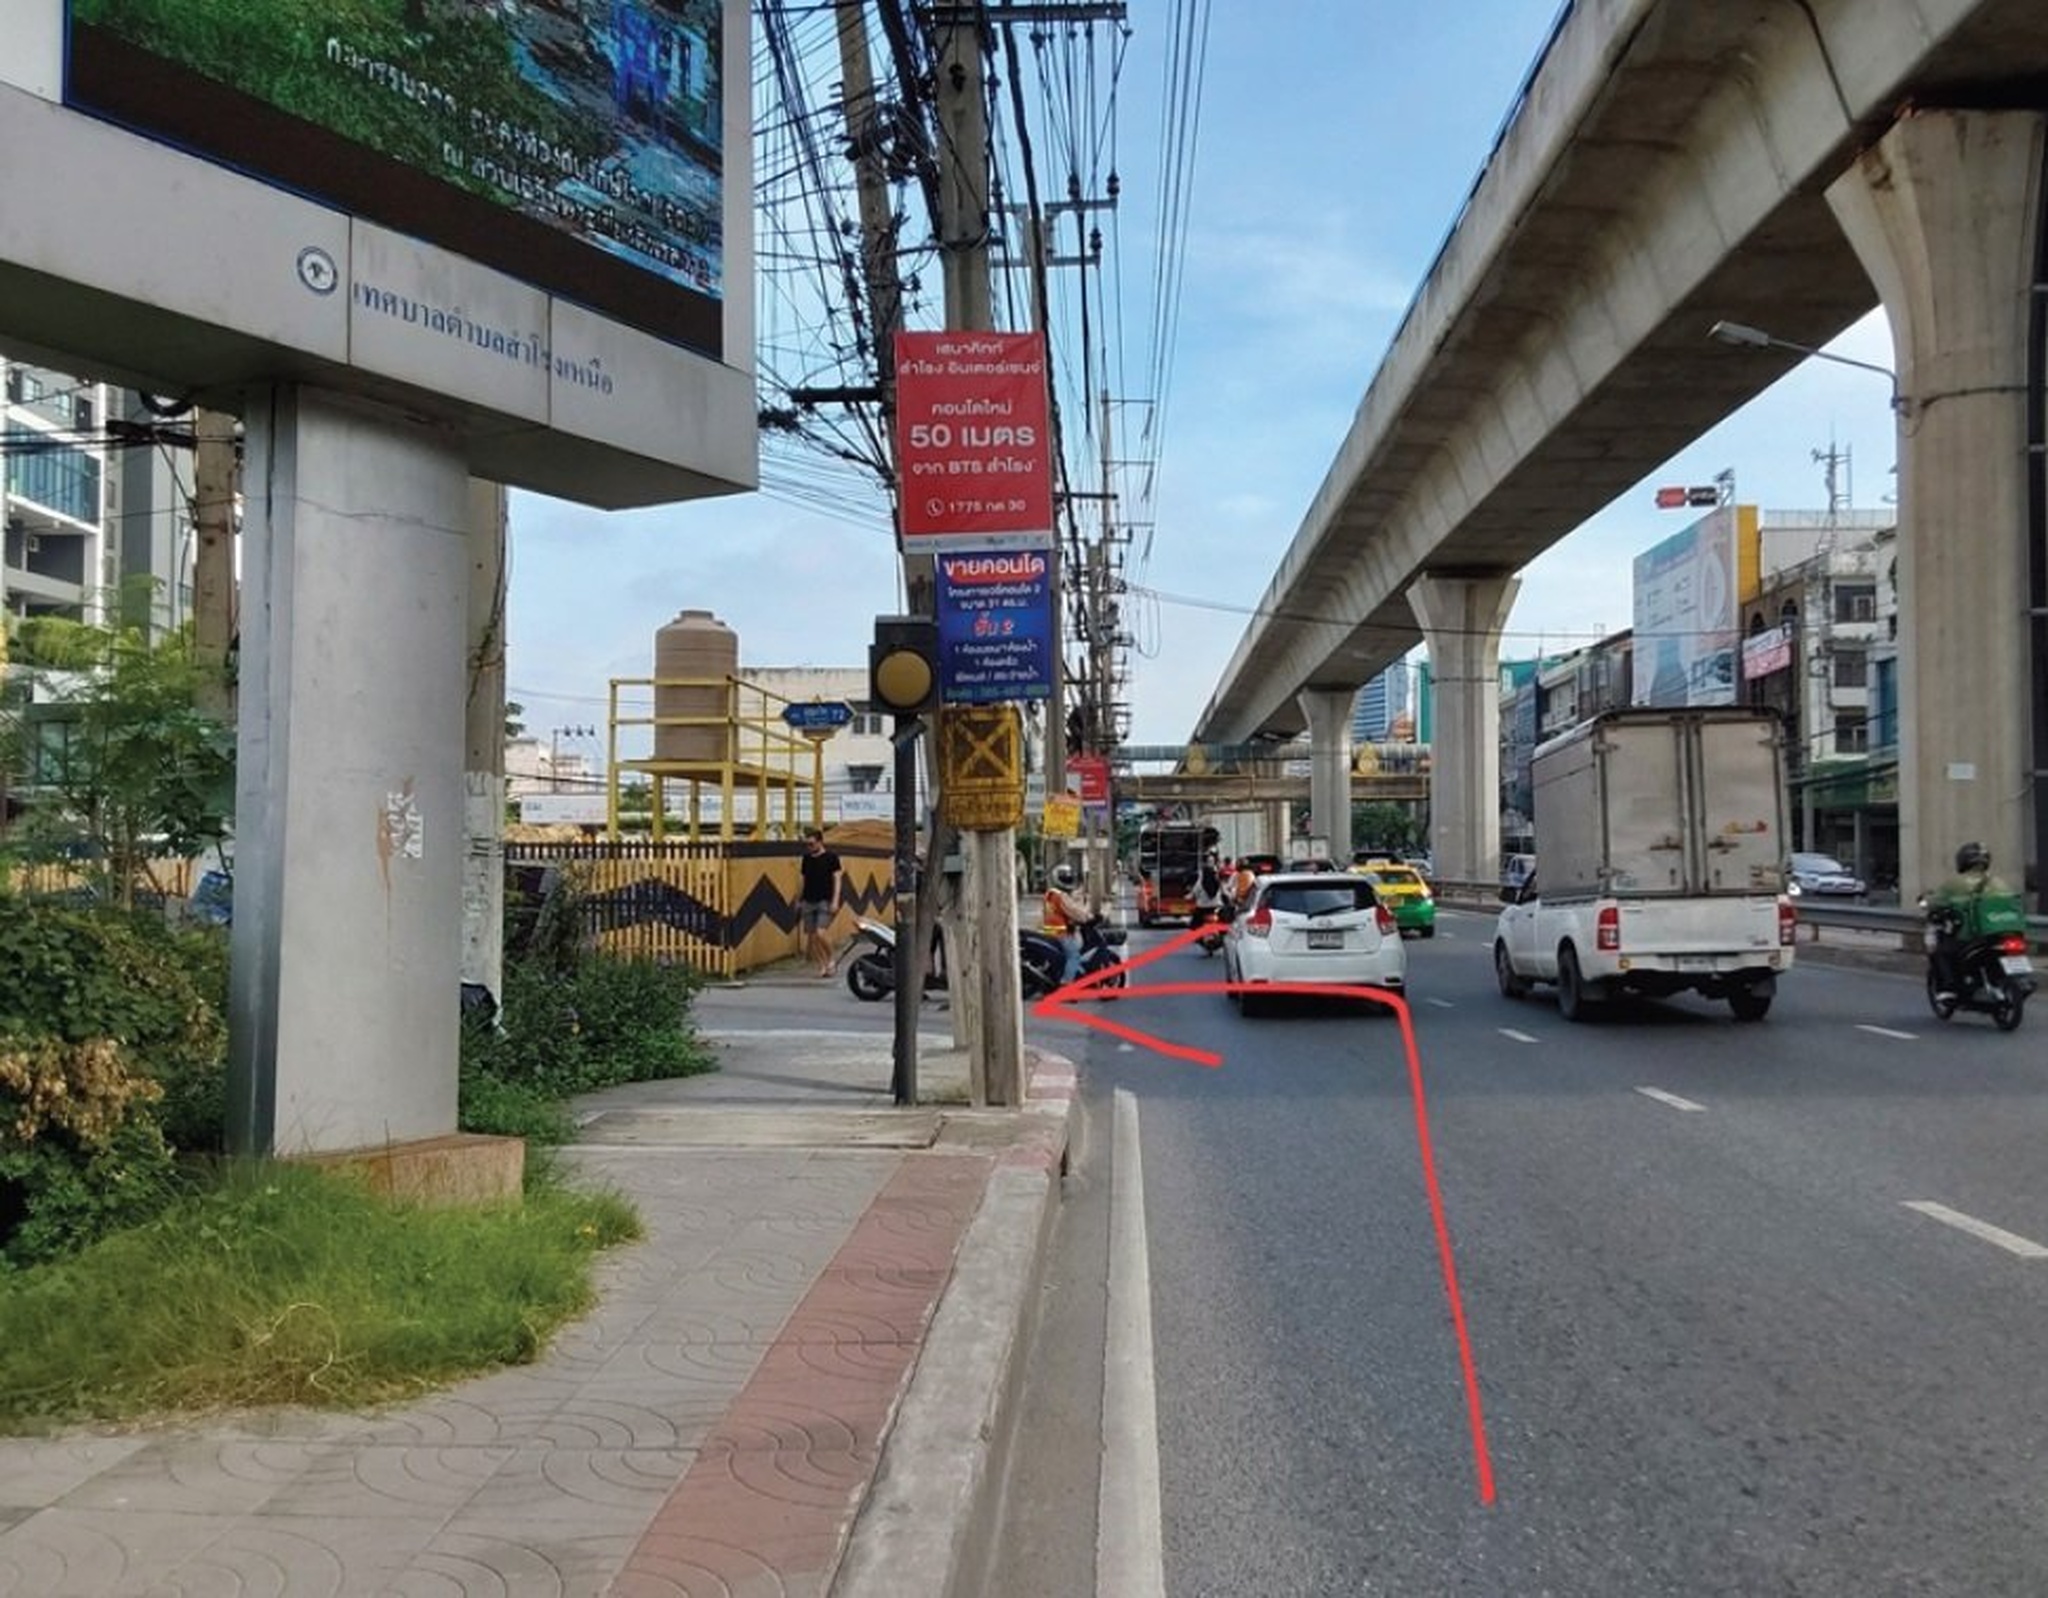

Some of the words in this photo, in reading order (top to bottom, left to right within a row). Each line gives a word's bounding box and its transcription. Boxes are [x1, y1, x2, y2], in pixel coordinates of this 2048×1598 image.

[353, 281, 614, 396] เทศบาลตำบลสำโรงเหนือ
[899, 360, 944, 375] สำโรง
[931, 398, 1013, 416] คอนโดใหม่
[909, 423, 952, 448] 50
[961, 425, 1036, 448] เมตร
[912, 461, 945, 475] จาก
[948, 460, 984, 474] BTS
[949, 500, 983, 514] 1775
[985, 501, 1005, 513] กด
[943, 552, 1046, 577] ขายคอนโด
